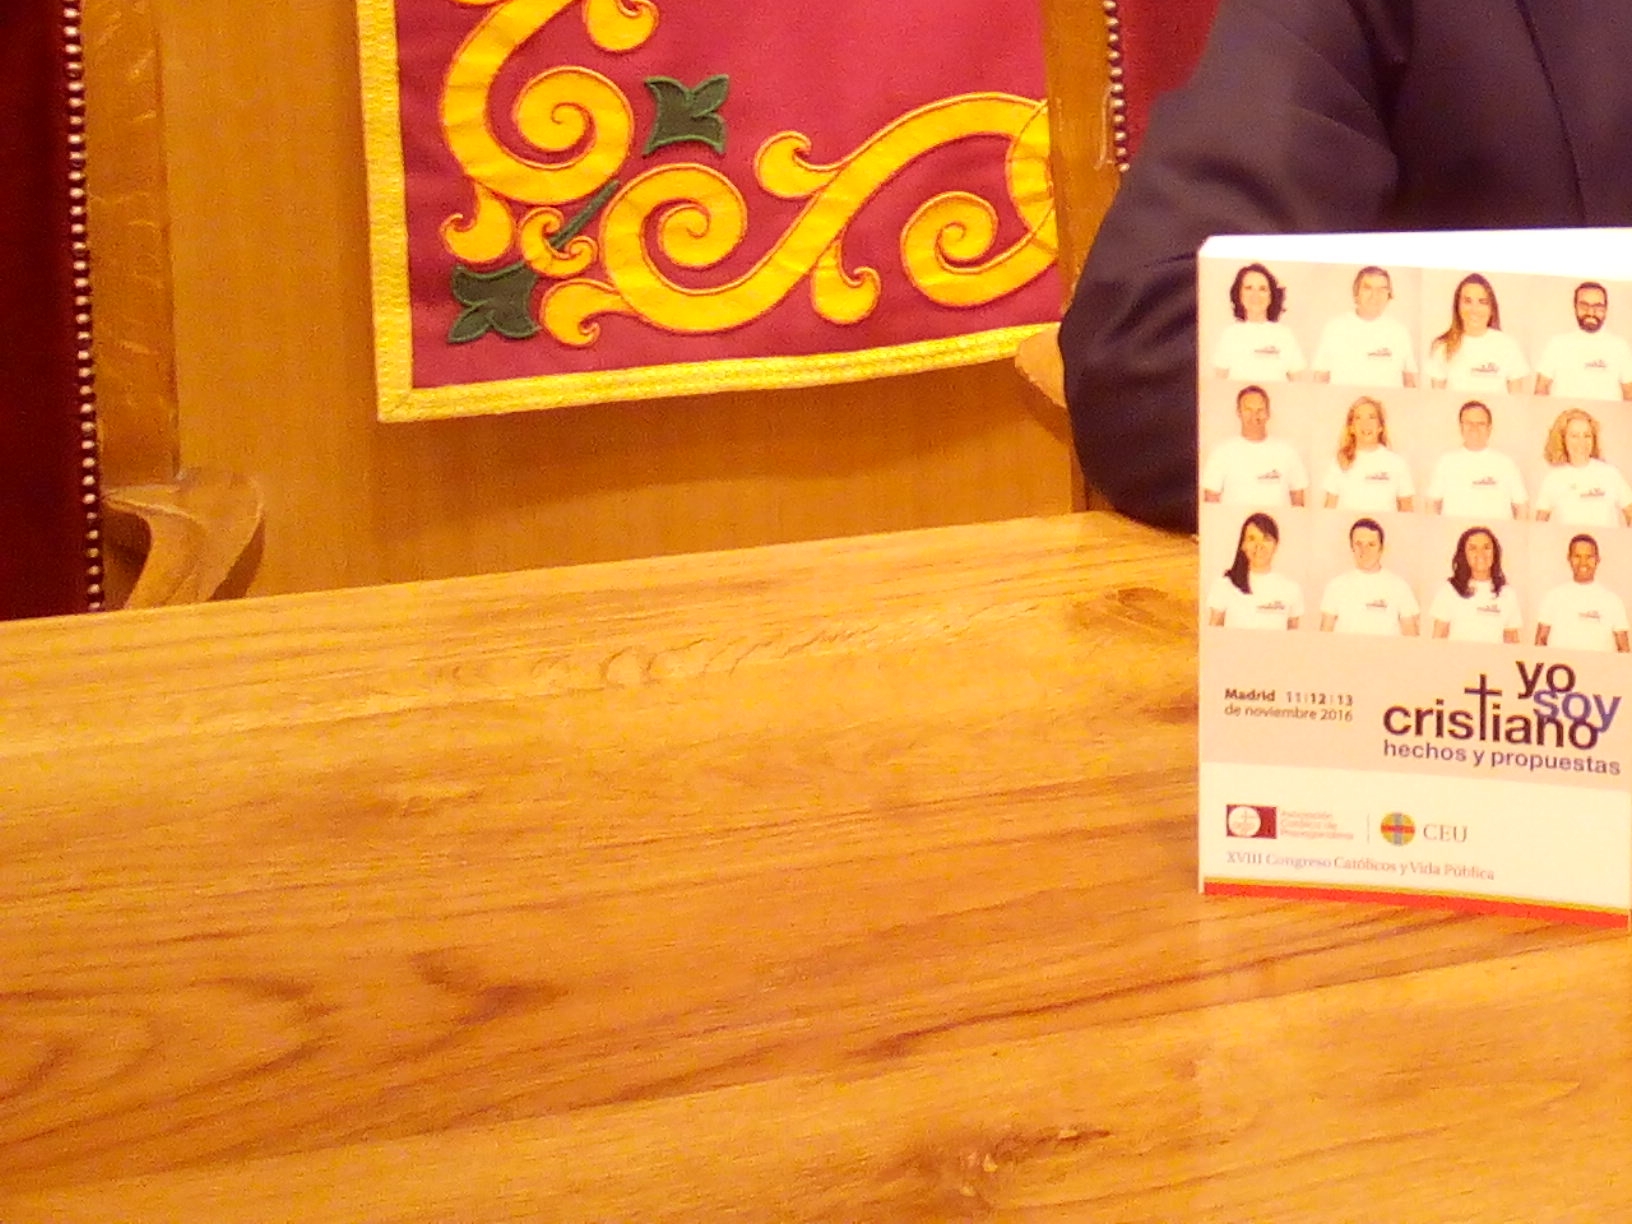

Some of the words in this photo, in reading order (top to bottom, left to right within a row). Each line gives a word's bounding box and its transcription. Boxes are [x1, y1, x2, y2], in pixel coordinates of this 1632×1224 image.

[1224, 687, 1276, 702] Madrid
[1515, 660, 1576, 699] yo
[1224, 702, 1241, 717] de
[1244, 706, 1318, 720] noviembre
[1320, 708, 1354, 722] 2016
[1383, 674, 1599, 751] cristiano
[1533, 687, 1622, 733] soy
[1383, 739, 1467, 762] hechos
[1473, 750, 1485, 767] y
[1491, 750, 1622, 775] propuestas
[1423, 823, 1468, 843] CEU
[1226, 851, 1262, 864] XVIII
[1265, 853, 1333, 869] Congreso
[1334, 856, 1397, 872] Católicos
[1400, 862, 1408, 876] y
[1410, 861, 1441, 875] Vida
